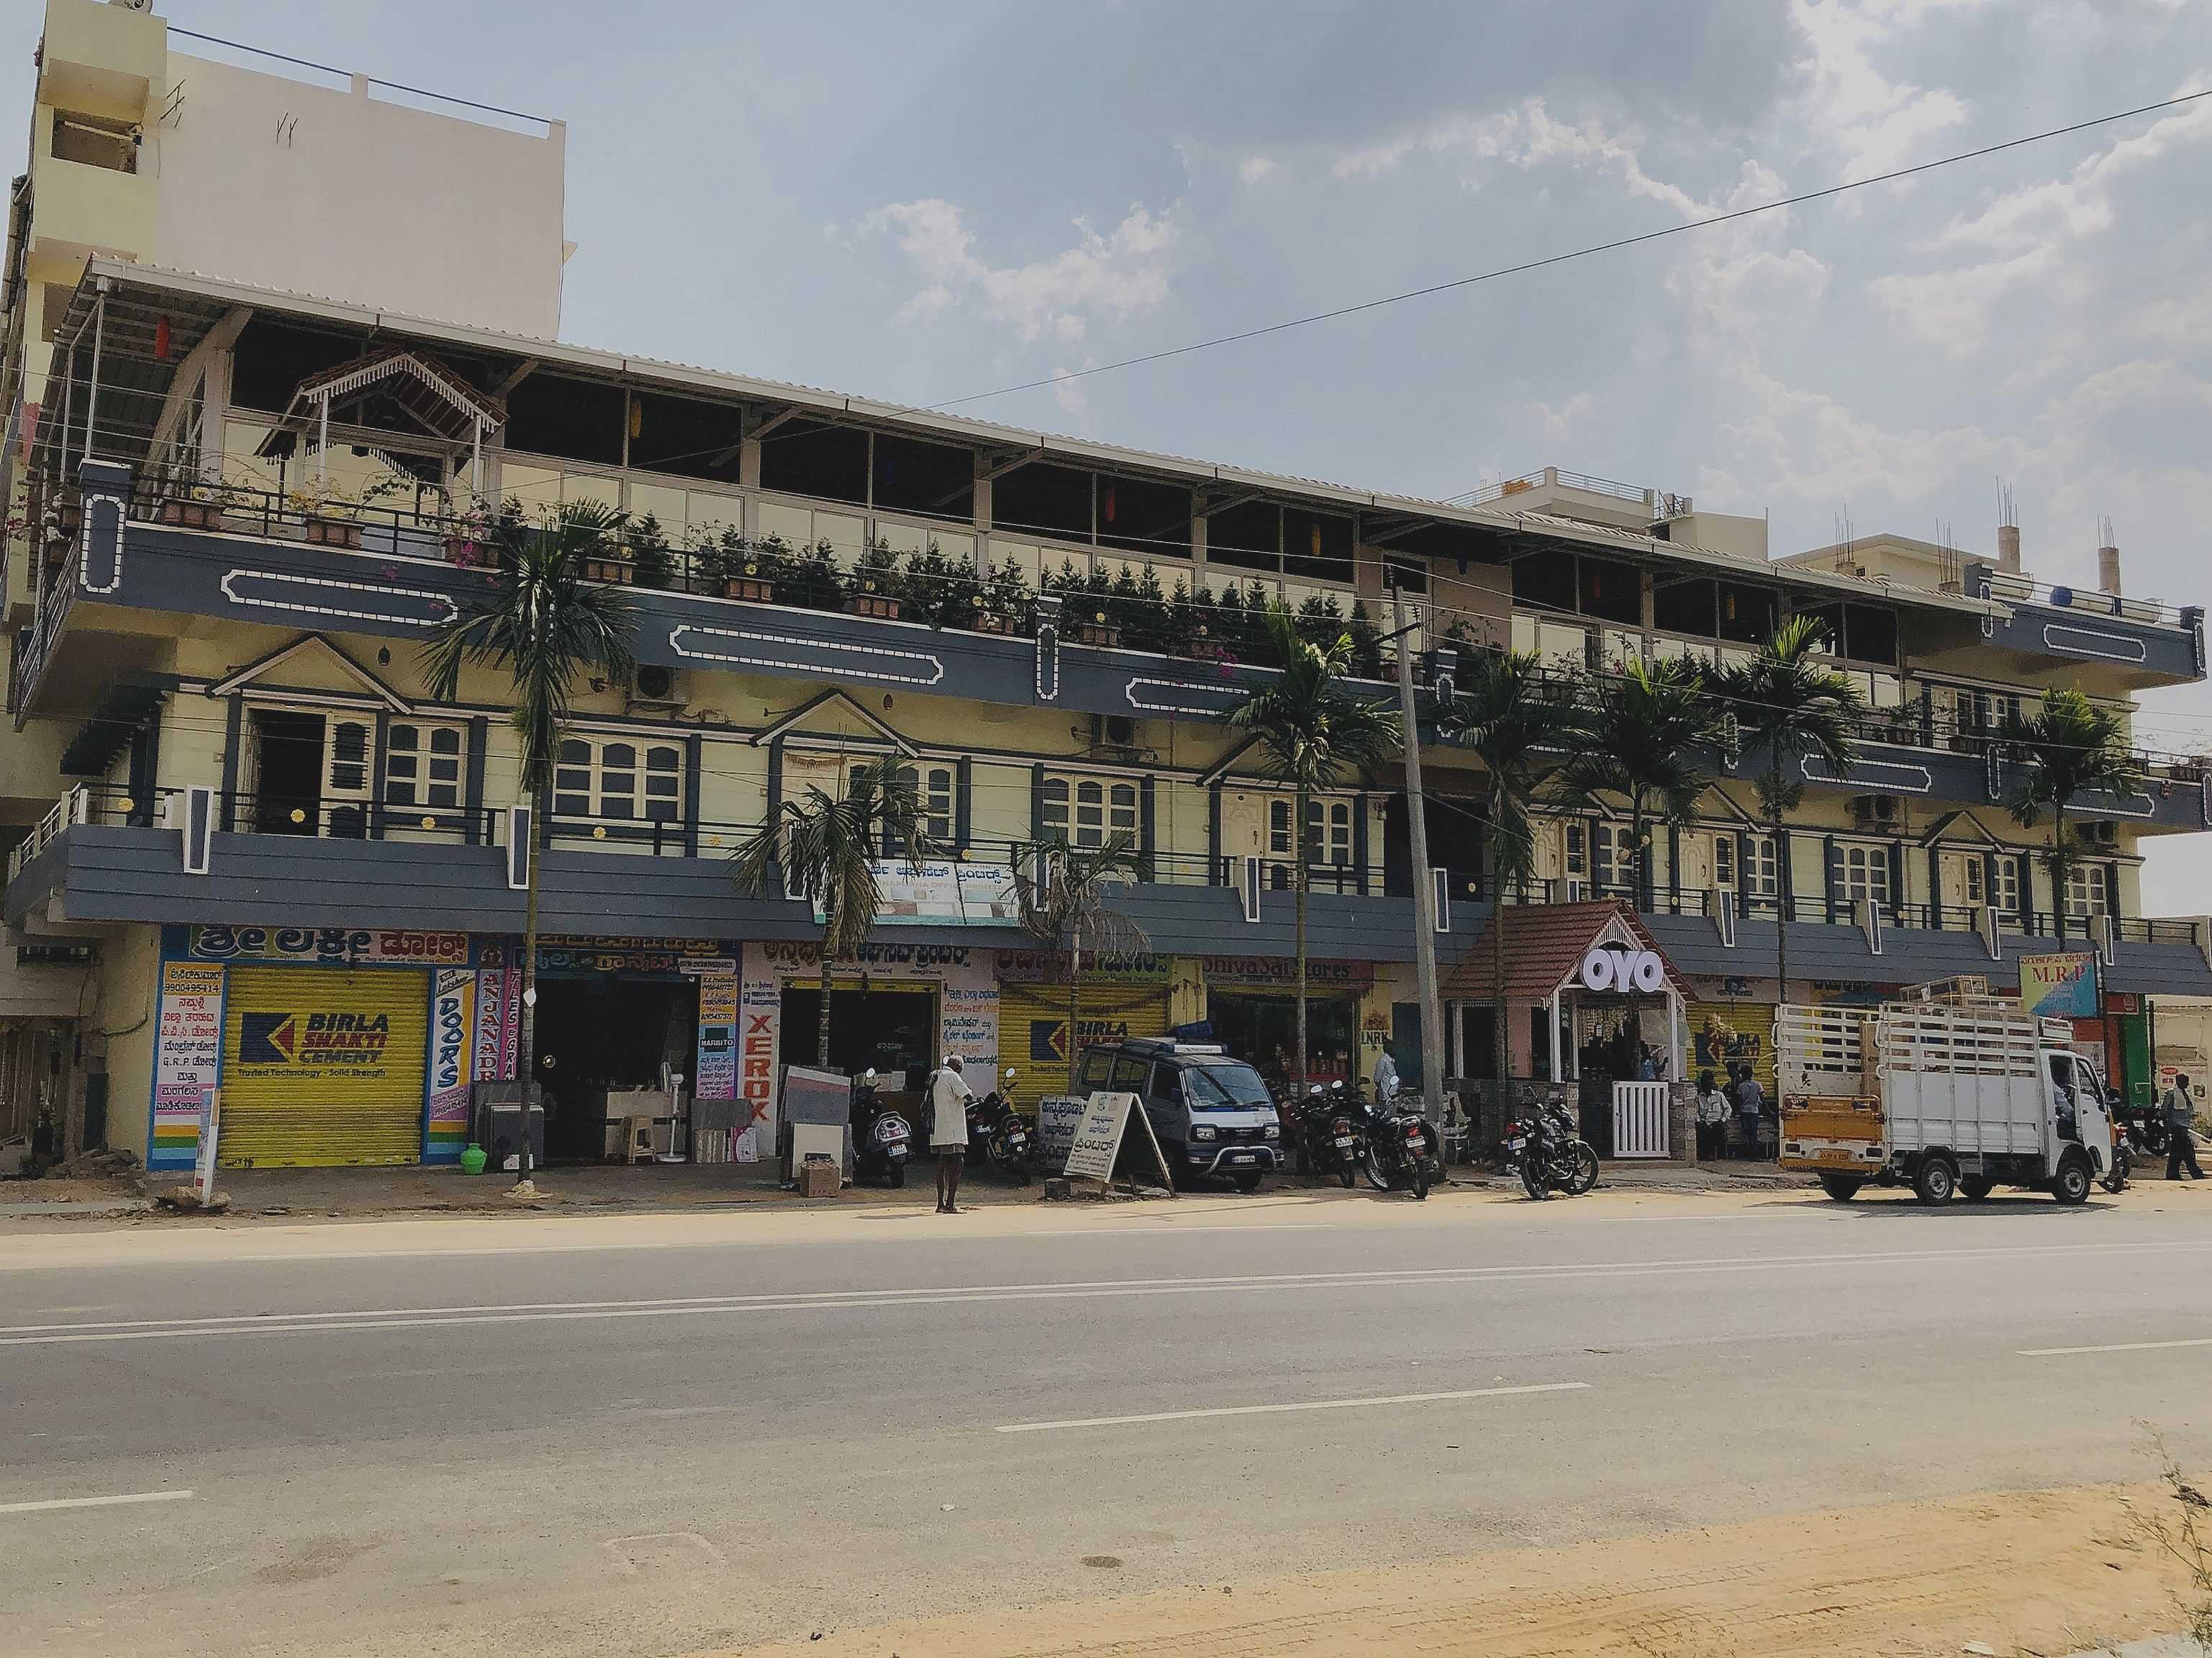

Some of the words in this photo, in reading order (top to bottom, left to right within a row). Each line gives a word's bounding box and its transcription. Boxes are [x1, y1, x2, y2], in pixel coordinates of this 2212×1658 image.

[1582, 948, 1664, 993] OYO
[2031, 965, 2086, 983] M.R.P
[307, 1013, 389, 1032] BIRLA
[476, 971, 502, 1082] ANJANADR
[302, 1032, 389, 1048] SHAKTI
[437, 997, 465, 1088] DOORS
[299, 1048, 384, 1064] CEMENT
[271, 1068, 321, 1079] Technology
[329, 1068, 349, 1077] Solid
[351, 1068, 386, 1079] Strength
[743, 1013, 773, 1122] XEROX
